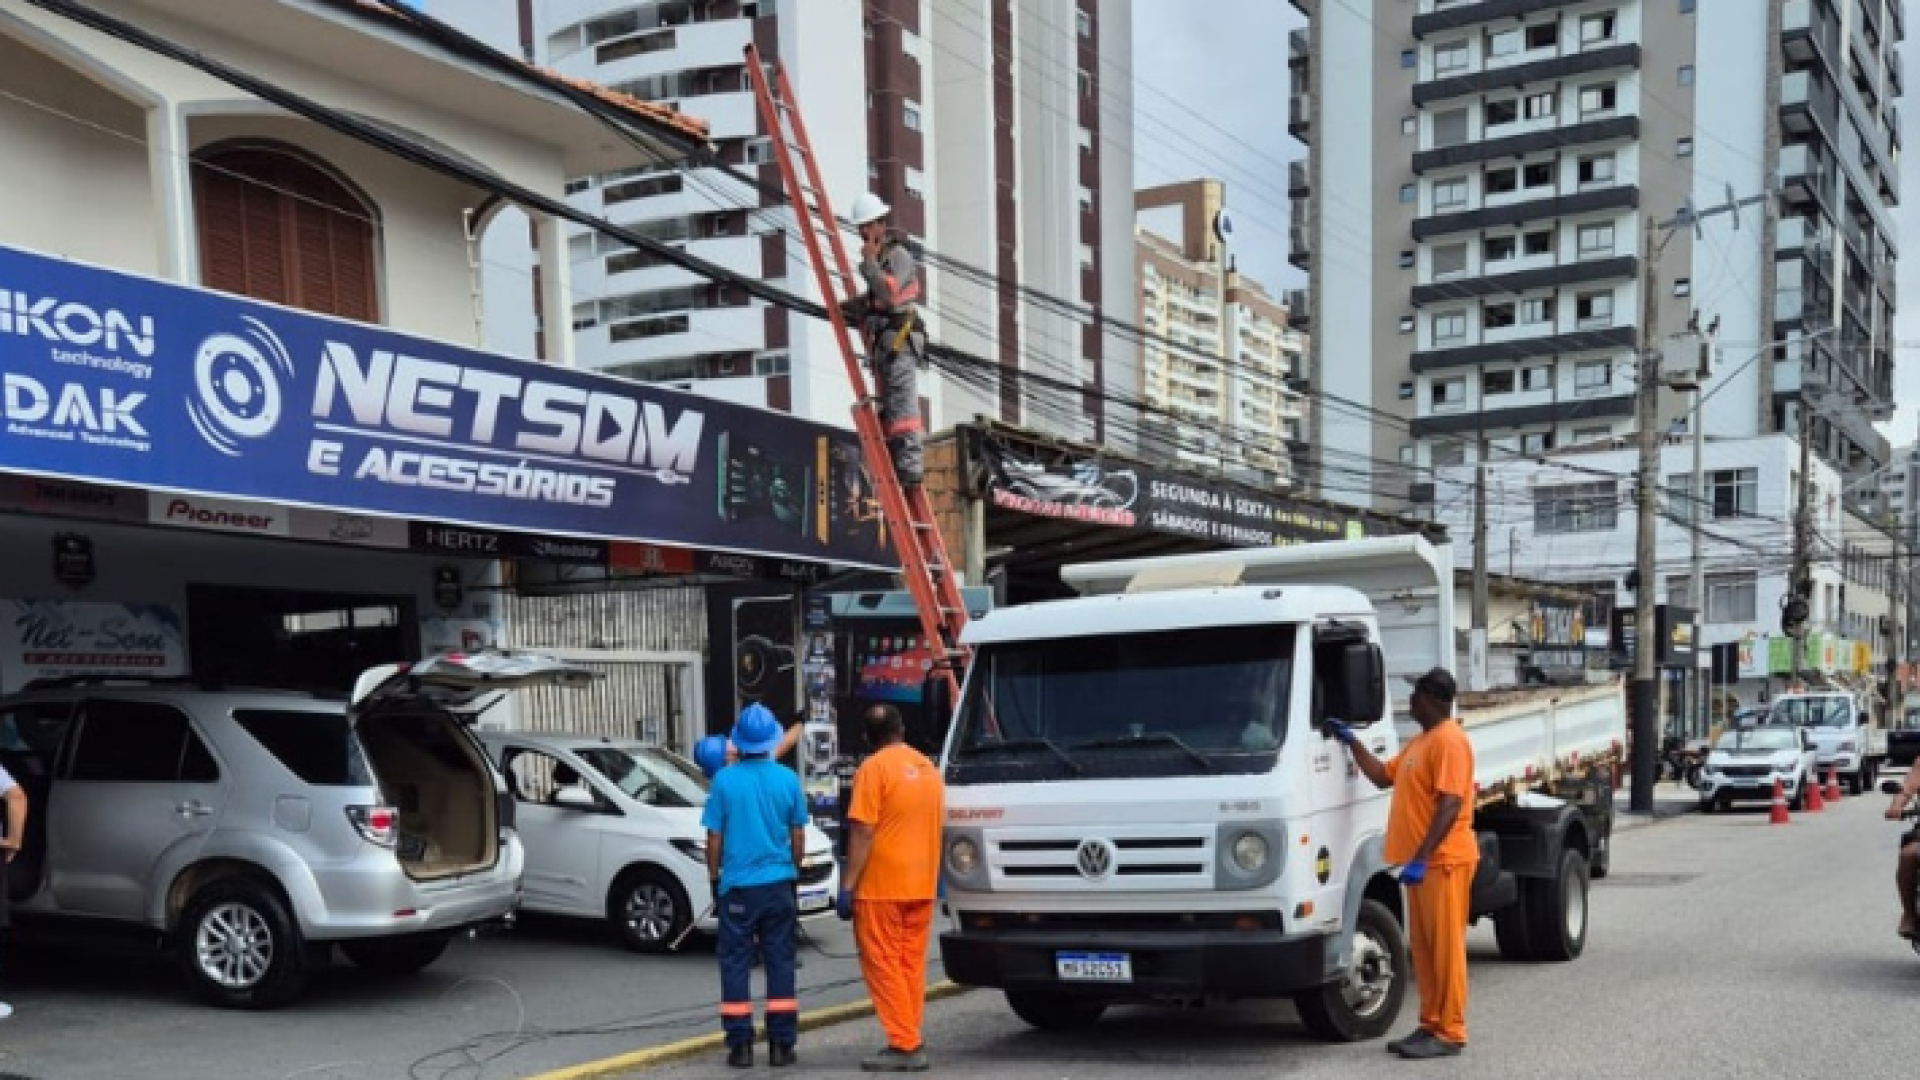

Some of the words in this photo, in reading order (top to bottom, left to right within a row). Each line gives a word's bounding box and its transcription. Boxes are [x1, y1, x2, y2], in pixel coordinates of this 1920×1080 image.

[51, 348, 152, 380] technology
[311, 340, 705, 472] NETSOM
[7, 421, 75, 440] Advanced
[80, 430, 151, 452] Technology
[308, 438, 343, 476] E
[355, 445, 616, 508] ACESSÓRIOS
[166, 499, 273, 530] Pioneer
[1150, 480, 1219, 510] SEGUNDA
[1236, 499, 1273, 520] SEXTA
[1152, 509, 1209, 535] SÁBADOS
[425, 525, 498, 552] HERTZ
